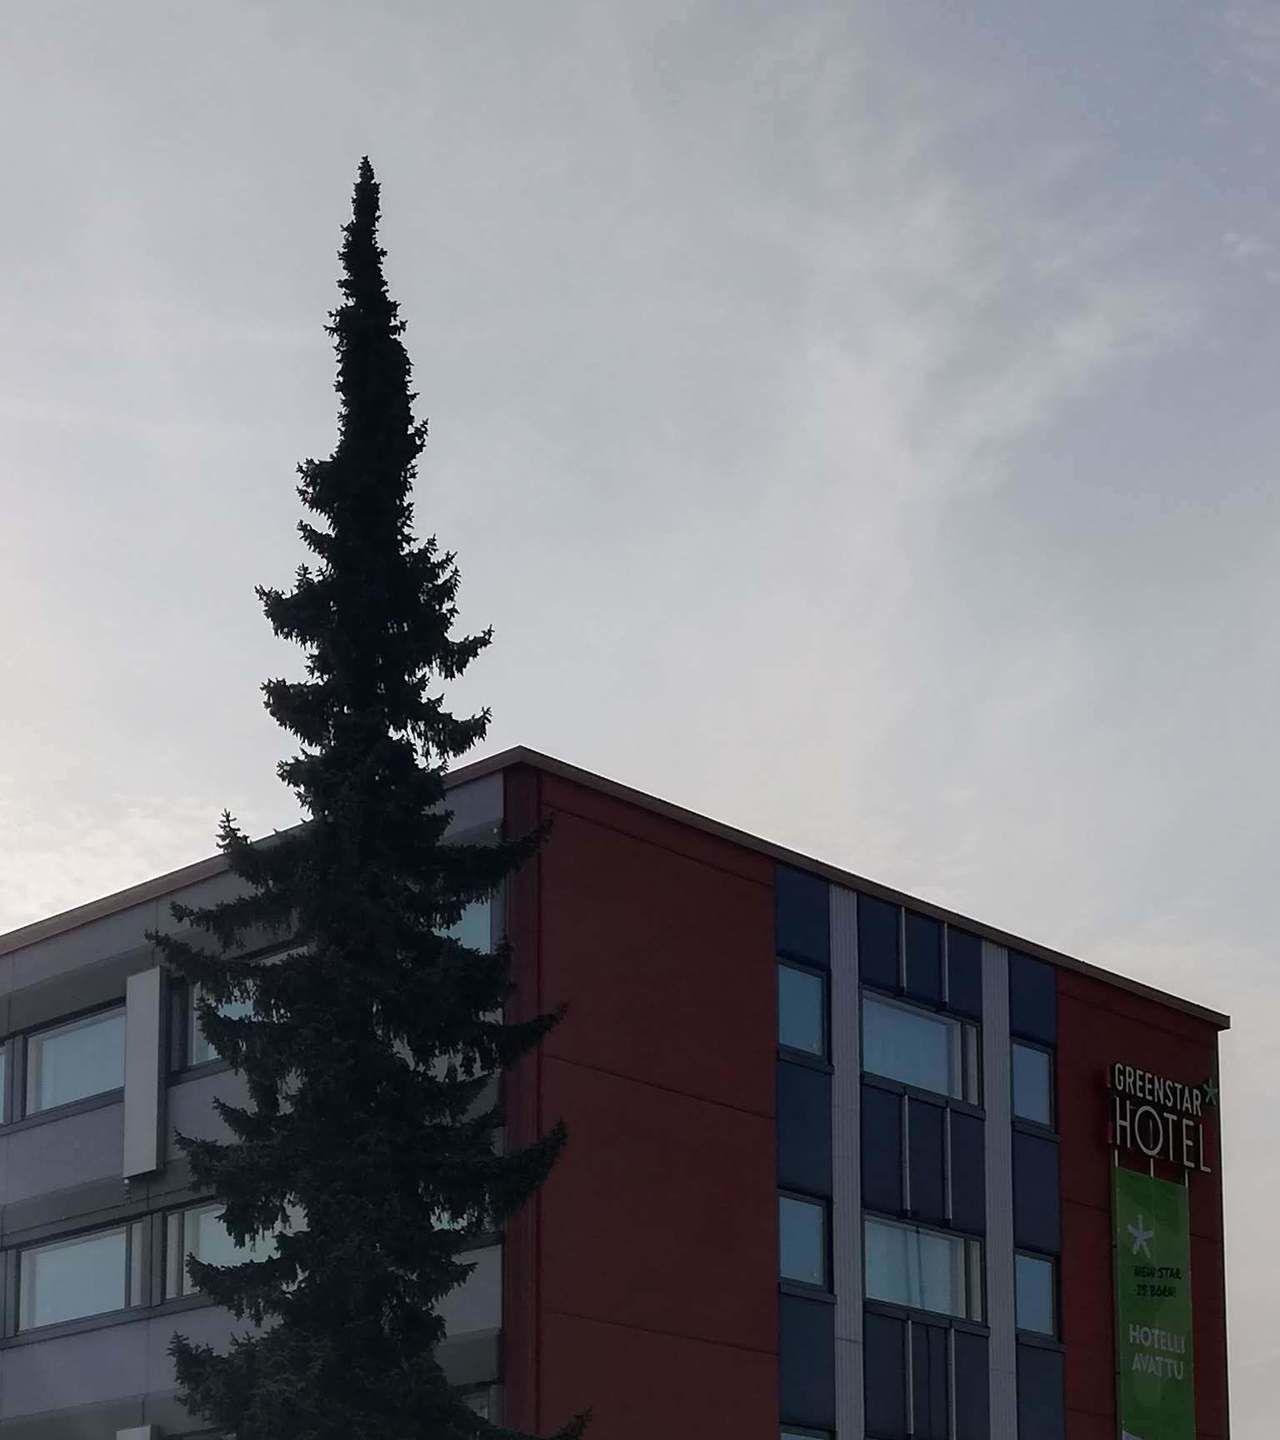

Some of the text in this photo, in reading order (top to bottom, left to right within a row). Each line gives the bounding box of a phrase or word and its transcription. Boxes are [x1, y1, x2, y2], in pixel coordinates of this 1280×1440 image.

[1114, 1063, 1202, 1117] GREENSTAR
[1116, 1096, 1212, 1173] HOTEL
[1129, 1324, 1186, 1354] HOTELLI
[1131, 1354, 1185, 1381] AVATTU
